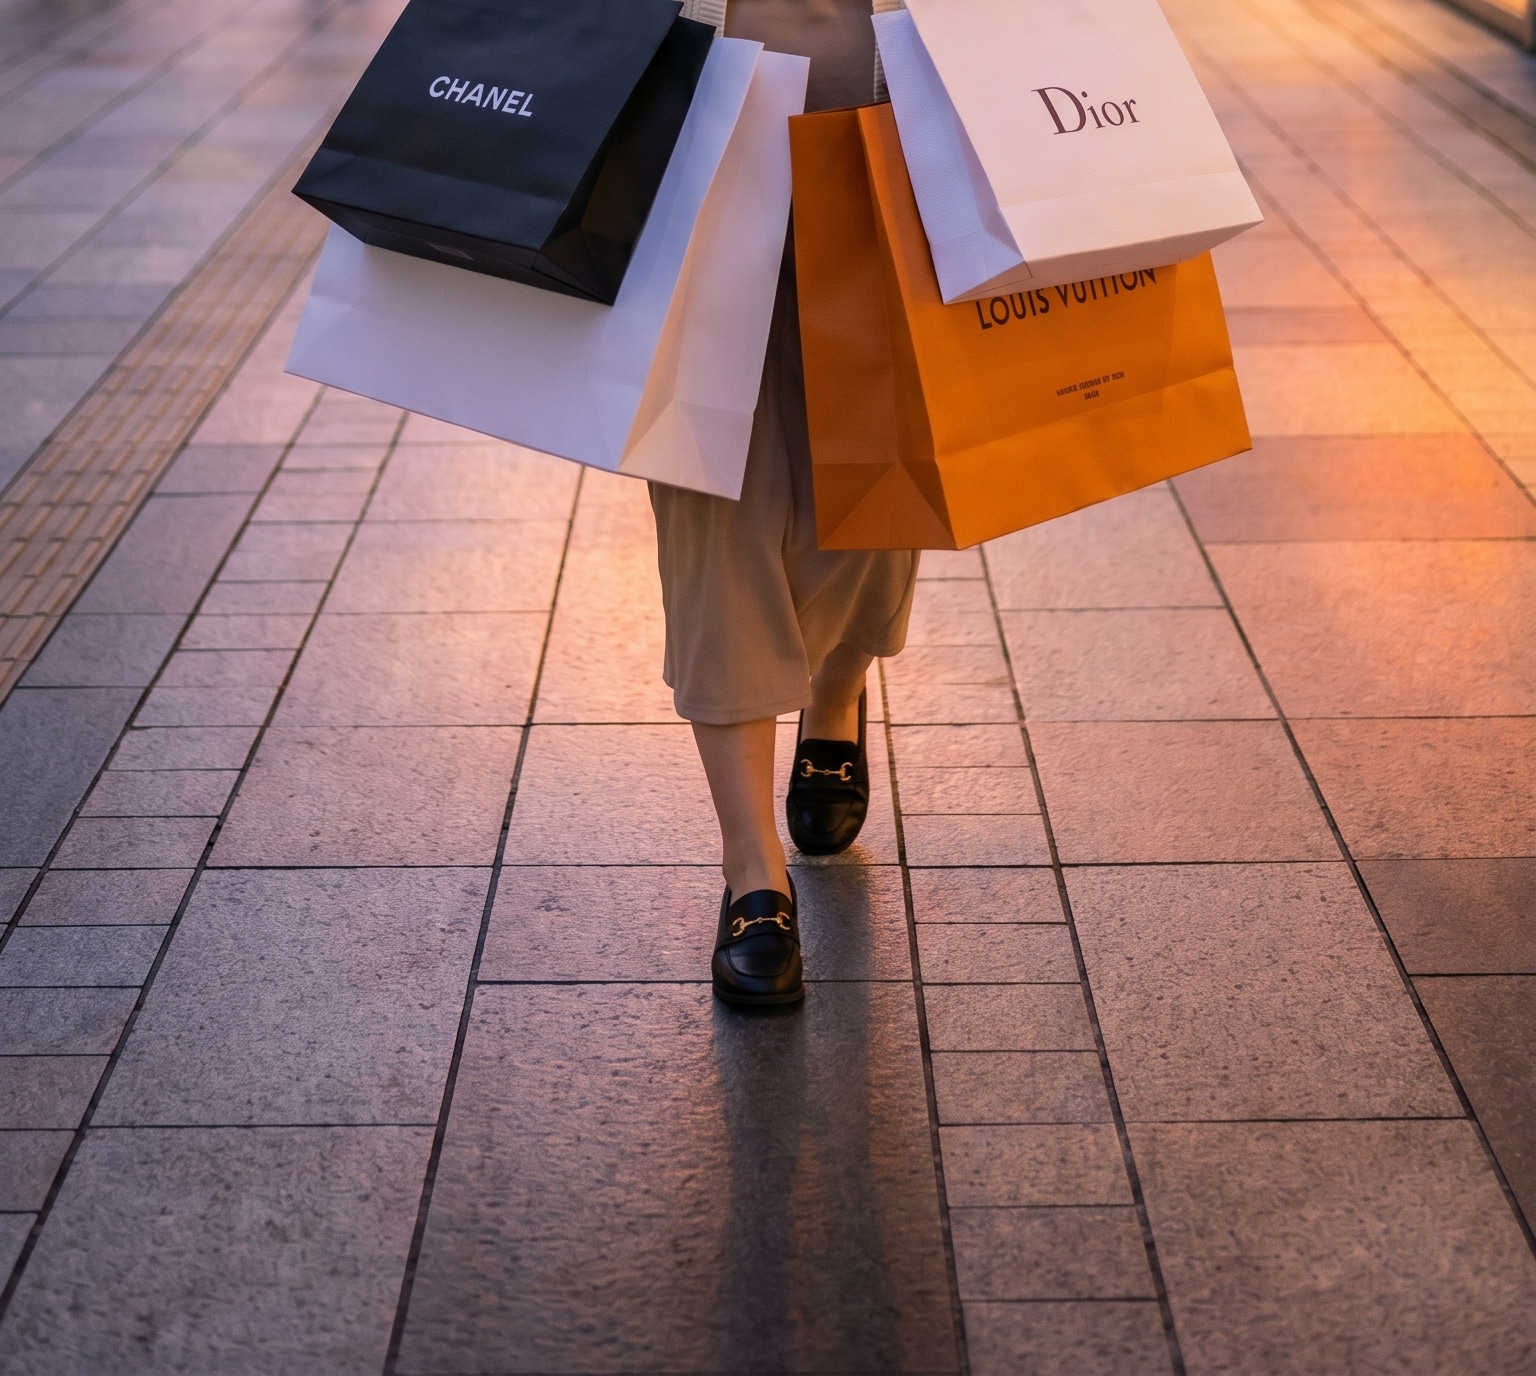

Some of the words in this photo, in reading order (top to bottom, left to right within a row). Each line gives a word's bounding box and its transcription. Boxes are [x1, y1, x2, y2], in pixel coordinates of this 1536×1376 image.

[428, 75, 534, 117] CHANEL
[1030, 86, 1141, 135] Dior
[975, 288, 1050, 330] LOUIS
